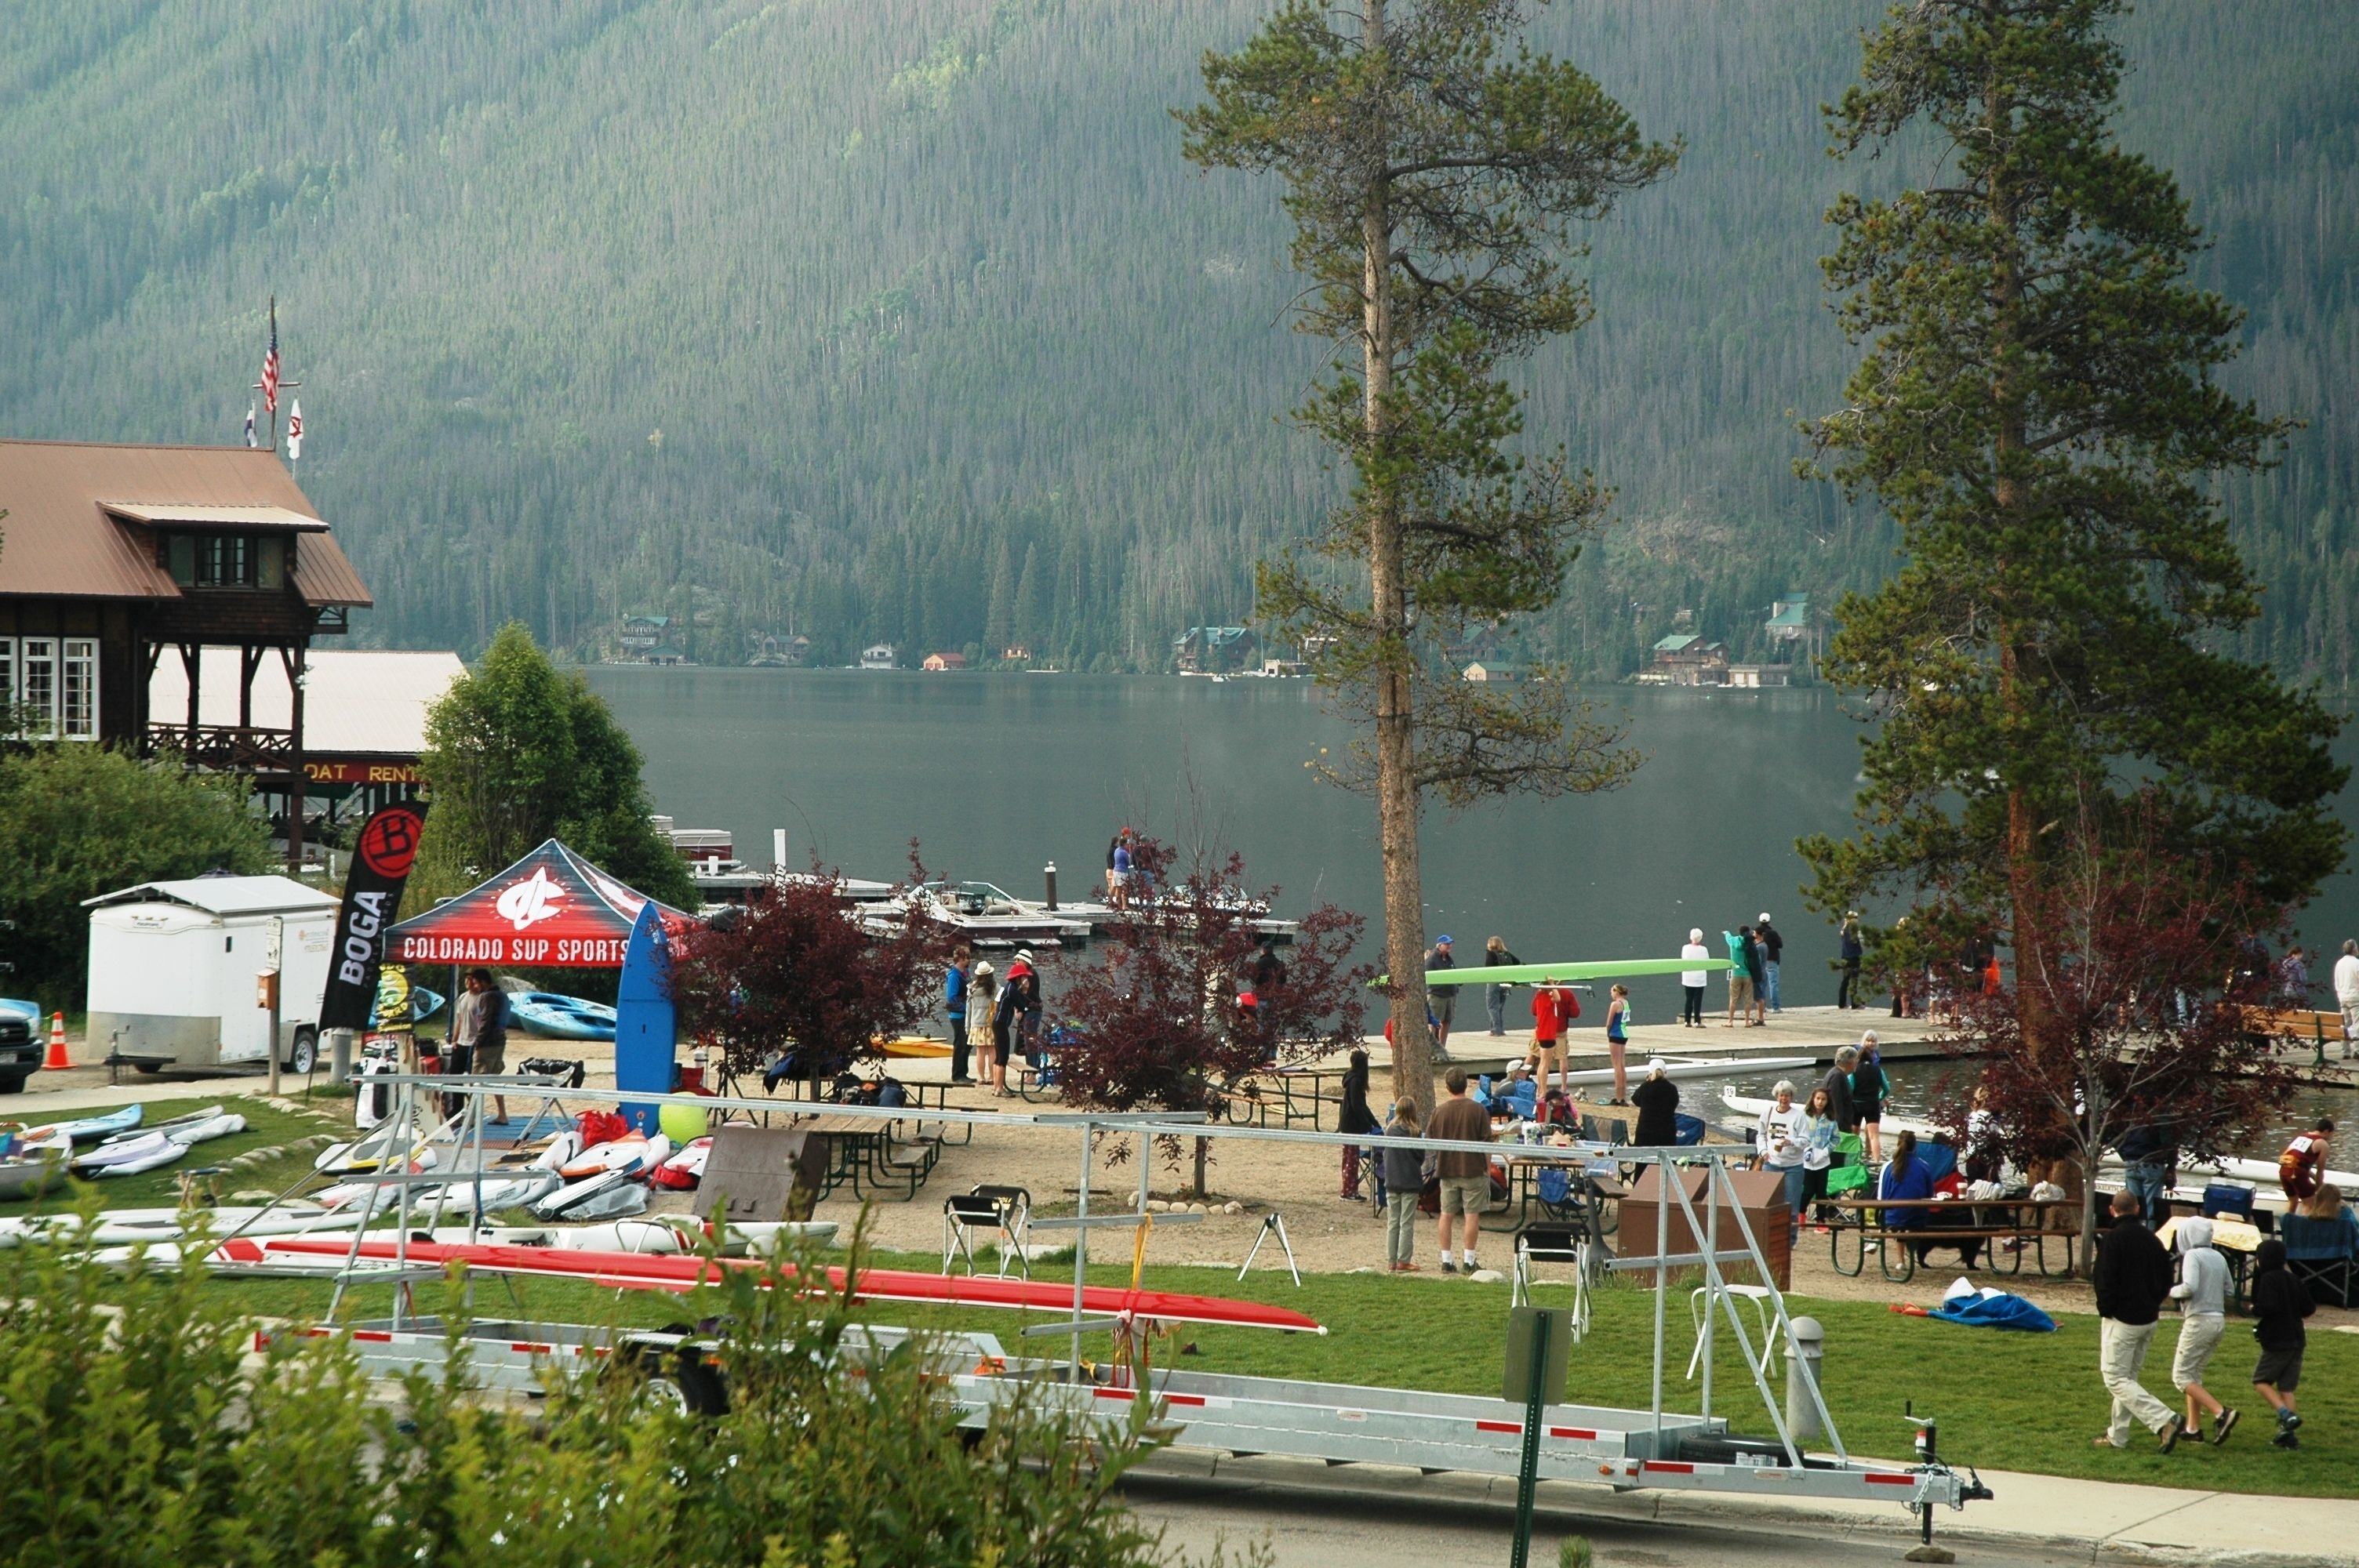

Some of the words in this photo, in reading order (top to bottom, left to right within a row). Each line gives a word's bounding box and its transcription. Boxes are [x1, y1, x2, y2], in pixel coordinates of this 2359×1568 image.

[304, 764, 347, 779] OAT
[369, 766, 416, 782] RENT
[339, 891, 387, 985] BOGA
[403, 937, 503, 960] COLORADO
[511, 938, 550, 961] SUP
